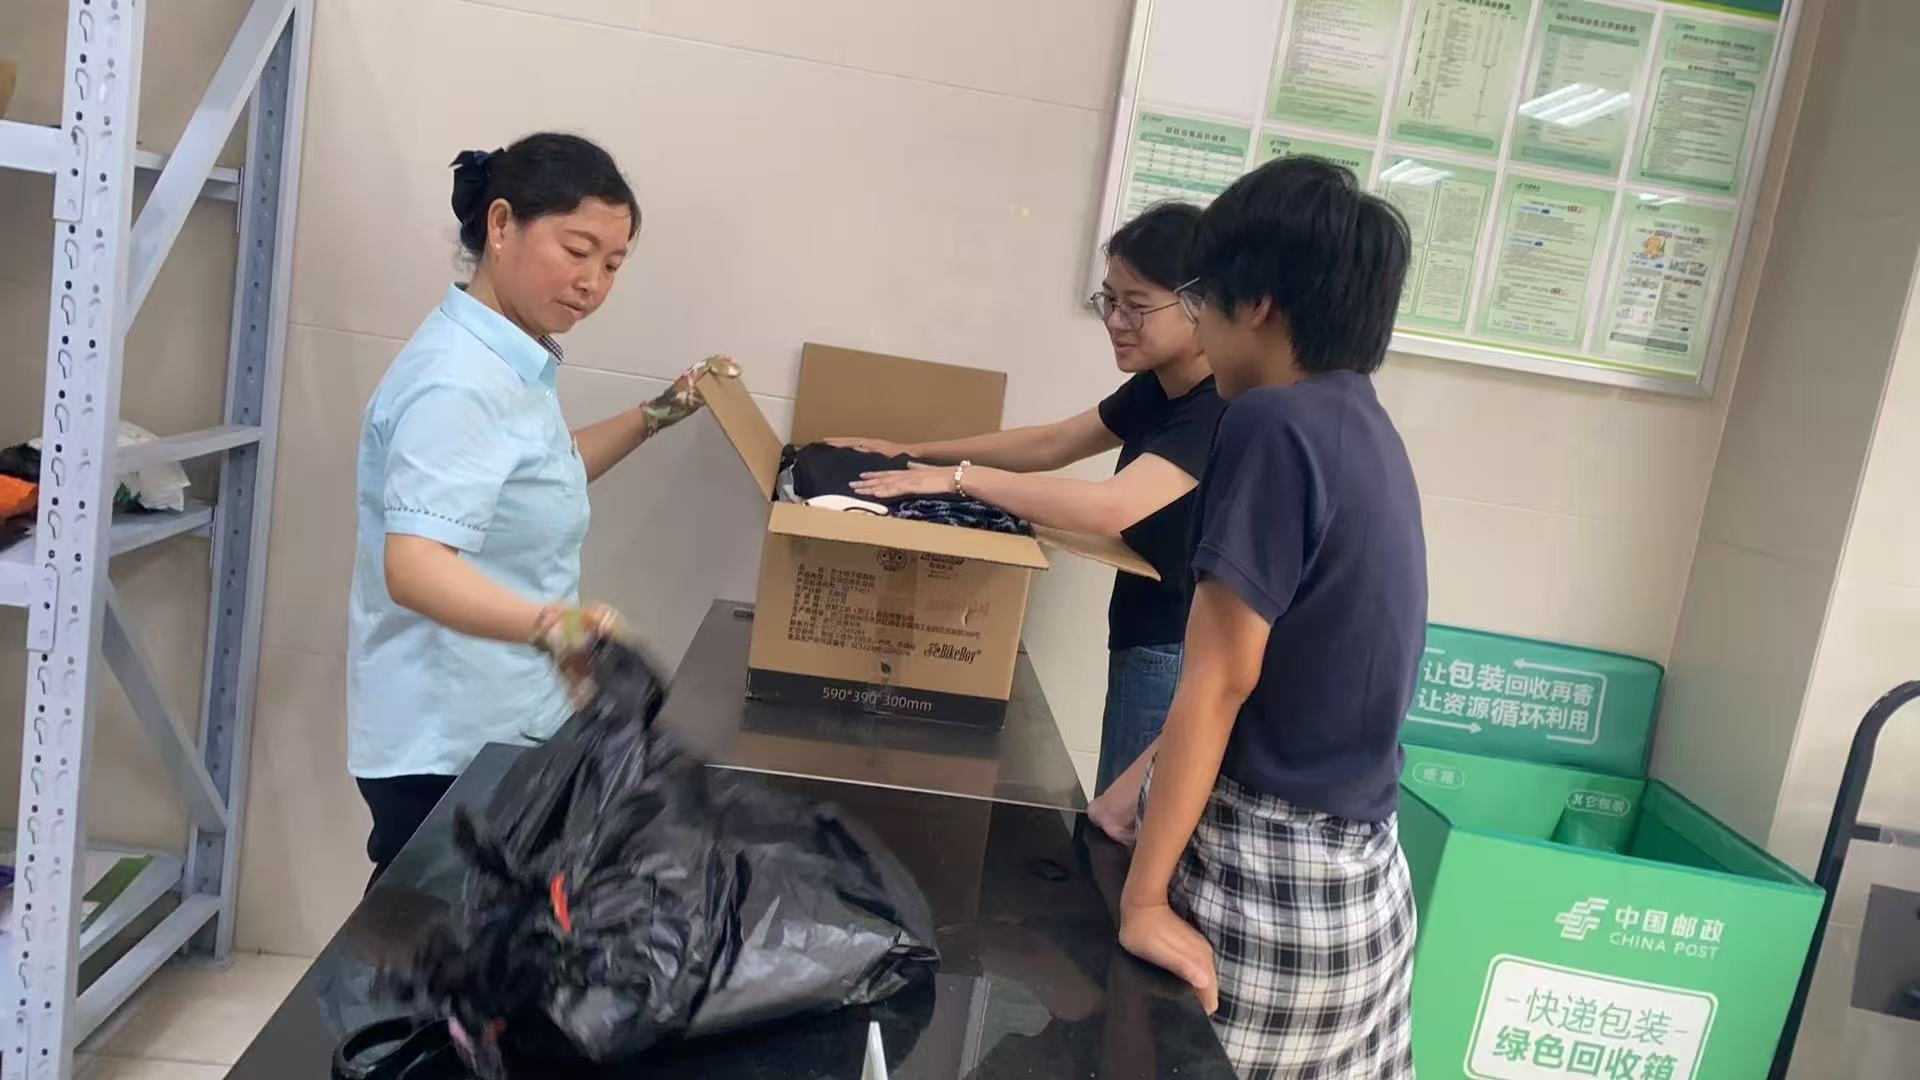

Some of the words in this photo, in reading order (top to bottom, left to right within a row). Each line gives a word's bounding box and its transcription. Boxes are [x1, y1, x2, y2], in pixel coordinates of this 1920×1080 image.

[1424, 658, 1595, 707] 让包装回收再寄
[1418, 687, 1590, 733] 让资源循环利用
[1609, 932, 1666, 953] CHINA
[1673, 942, 1721, 960] POST
[1615, 905, 1726, 943] 中国邮政
[1492, 1024, 1679, 1080] 绿色回收箱
